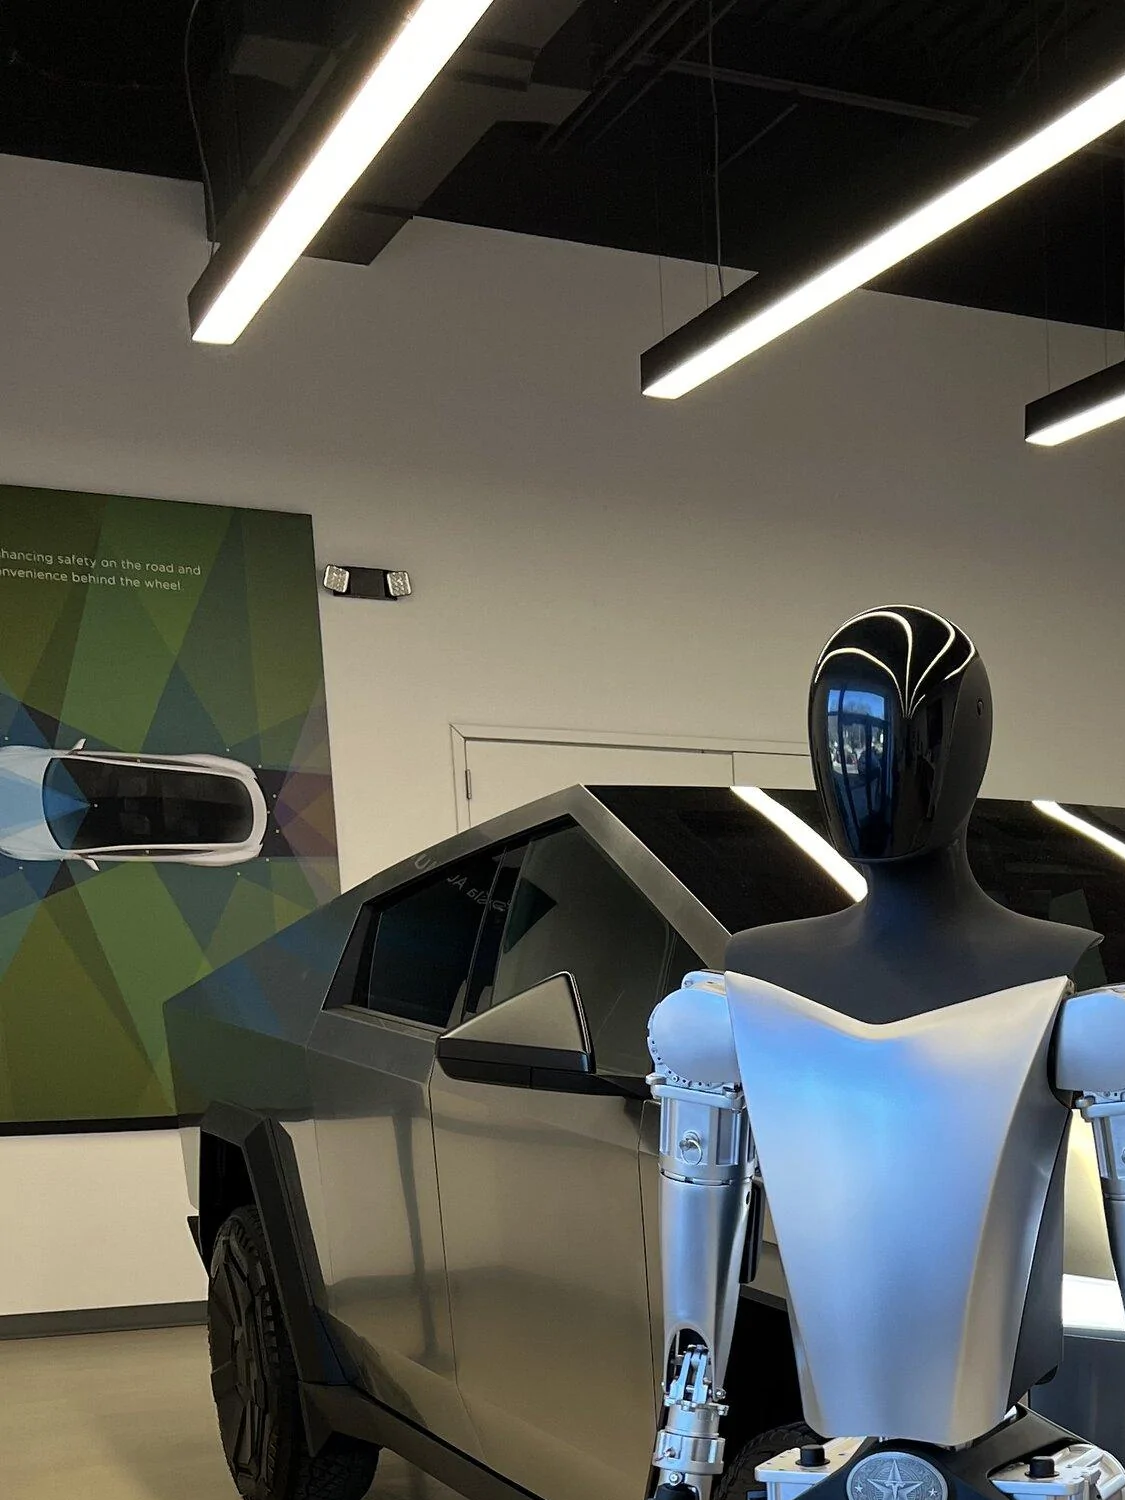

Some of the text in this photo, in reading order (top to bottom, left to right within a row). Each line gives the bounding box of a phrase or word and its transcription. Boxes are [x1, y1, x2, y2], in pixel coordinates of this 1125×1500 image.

[0, 548, 201, 575] hancing safety on the road and
[0, 568, 68, 582] nvenience
[71, 571, 116, 585] behind
[120, 576, 140, 587] the
